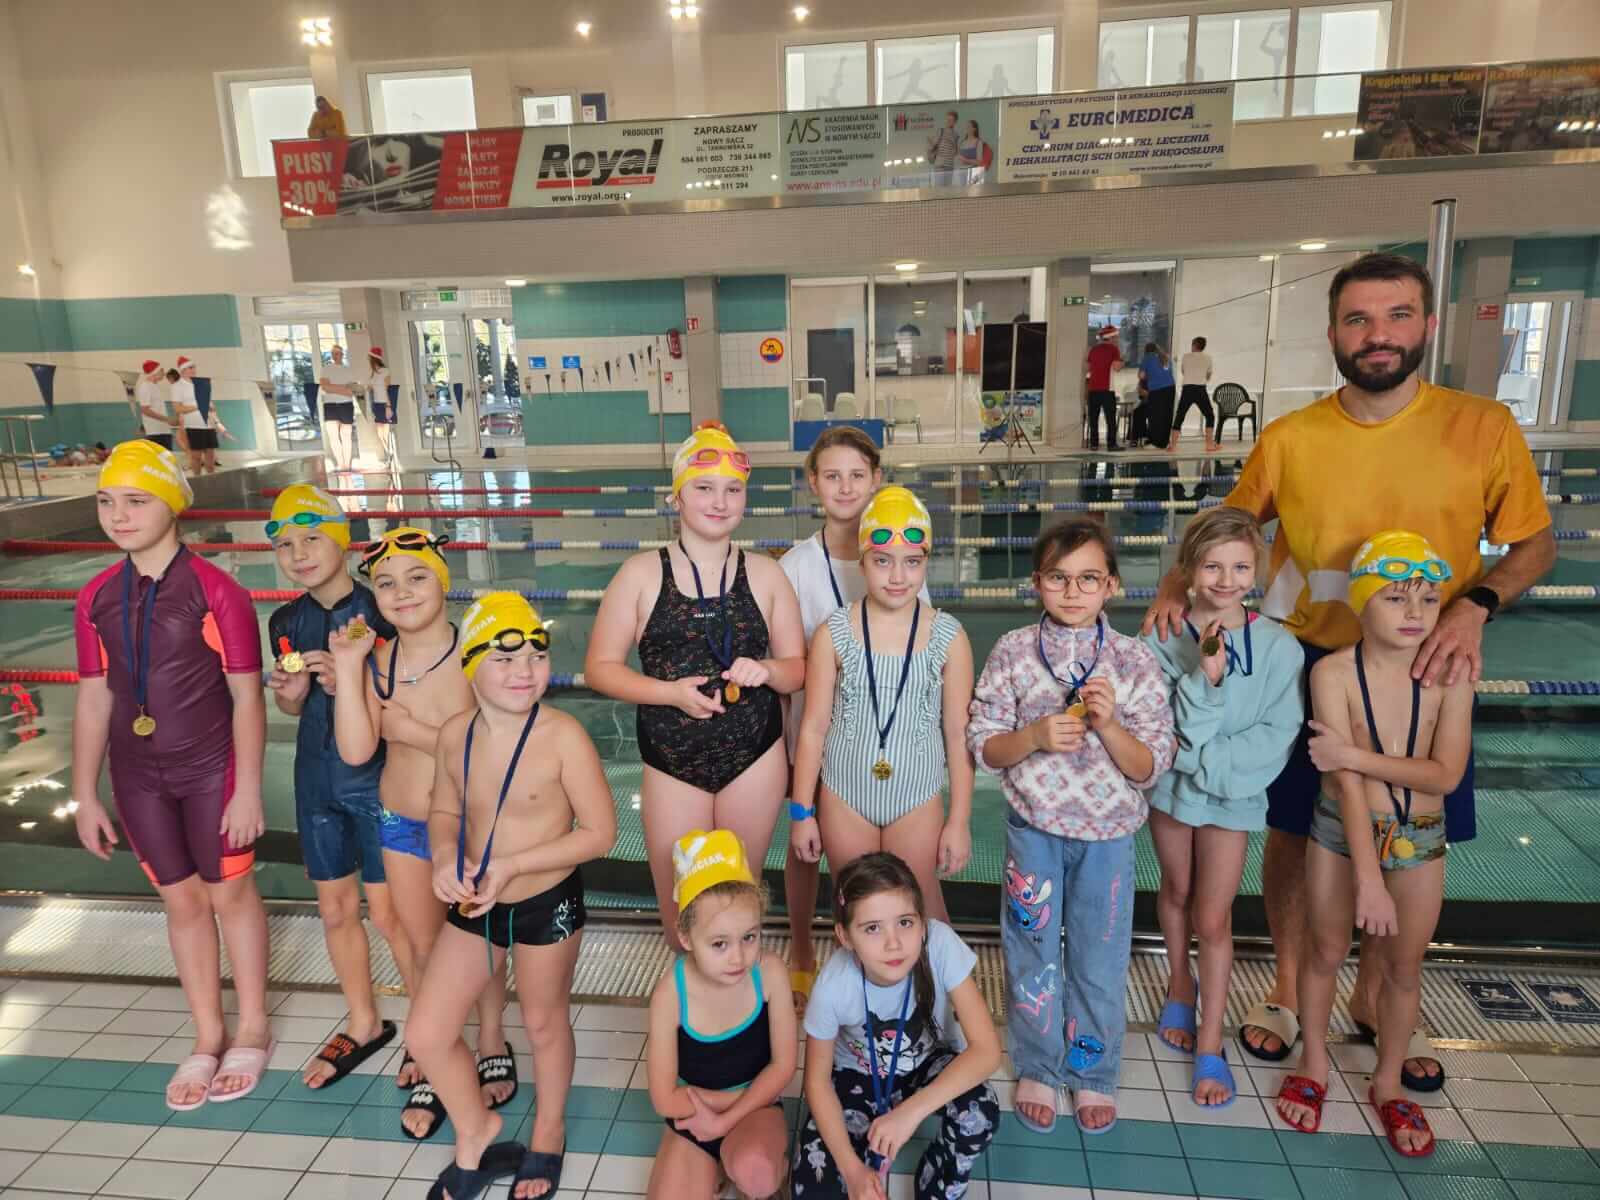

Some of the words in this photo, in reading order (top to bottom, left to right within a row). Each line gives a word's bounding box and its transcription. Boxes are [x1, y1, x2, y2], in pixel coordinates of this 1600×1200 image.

[1067, 105, 1195, 127] EUROMEDICA
[622, 127, 665, 137] PRODUCENT
[693, 123, 758, 135] ZAPRASZAMY
[1156, 134, 1210, 145] LECZENIA
[282, 151, 333, 176] PLISY
[537, 138, 665, 187] Royal
[1012, 153, 1089, 166] REHABILITACJI
[281, 179, 337, 205] -30%
[551, 190, 633, 203] www.royal.org.p
